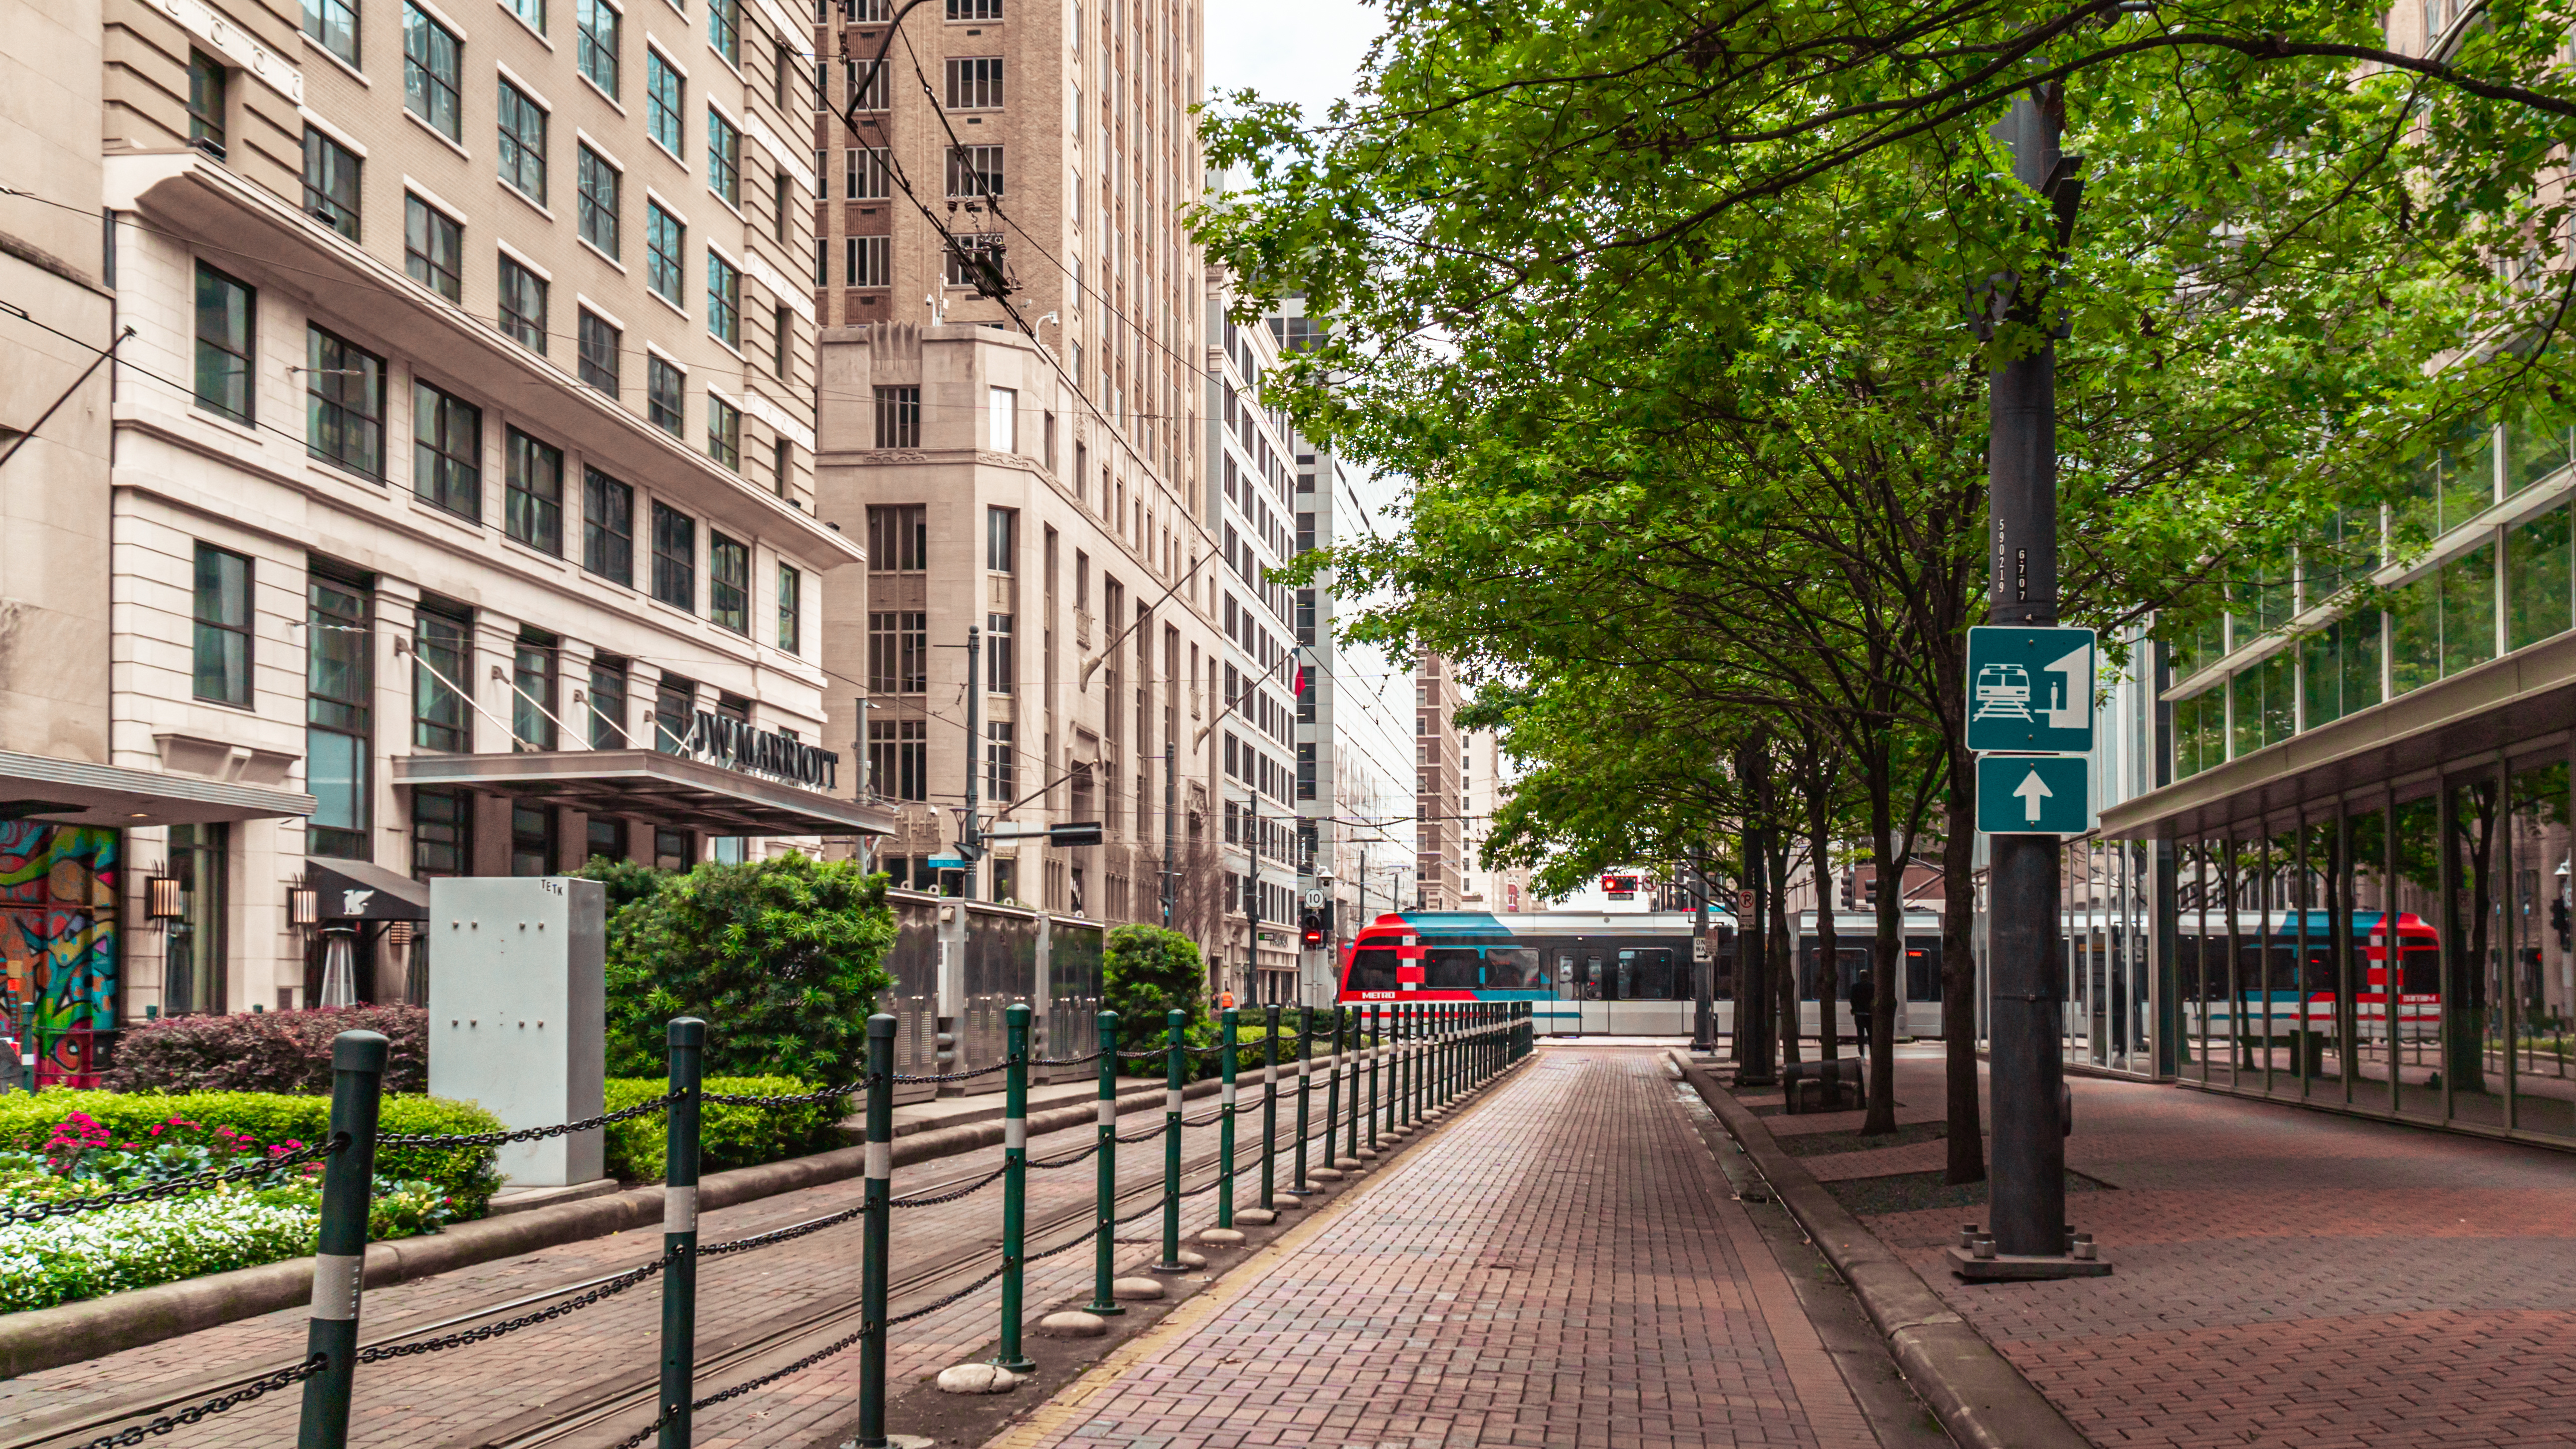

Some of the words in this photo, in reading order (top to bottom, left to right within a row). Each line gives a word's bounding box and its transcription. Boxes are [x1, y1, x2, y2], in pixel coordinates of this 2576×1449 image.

[694, 710, 732, 759] JW
[734, 722, 839, 789] MARRIOTT
[541, 879, 563, 896] TETK
[1309, 894, 1320, 904] 10
